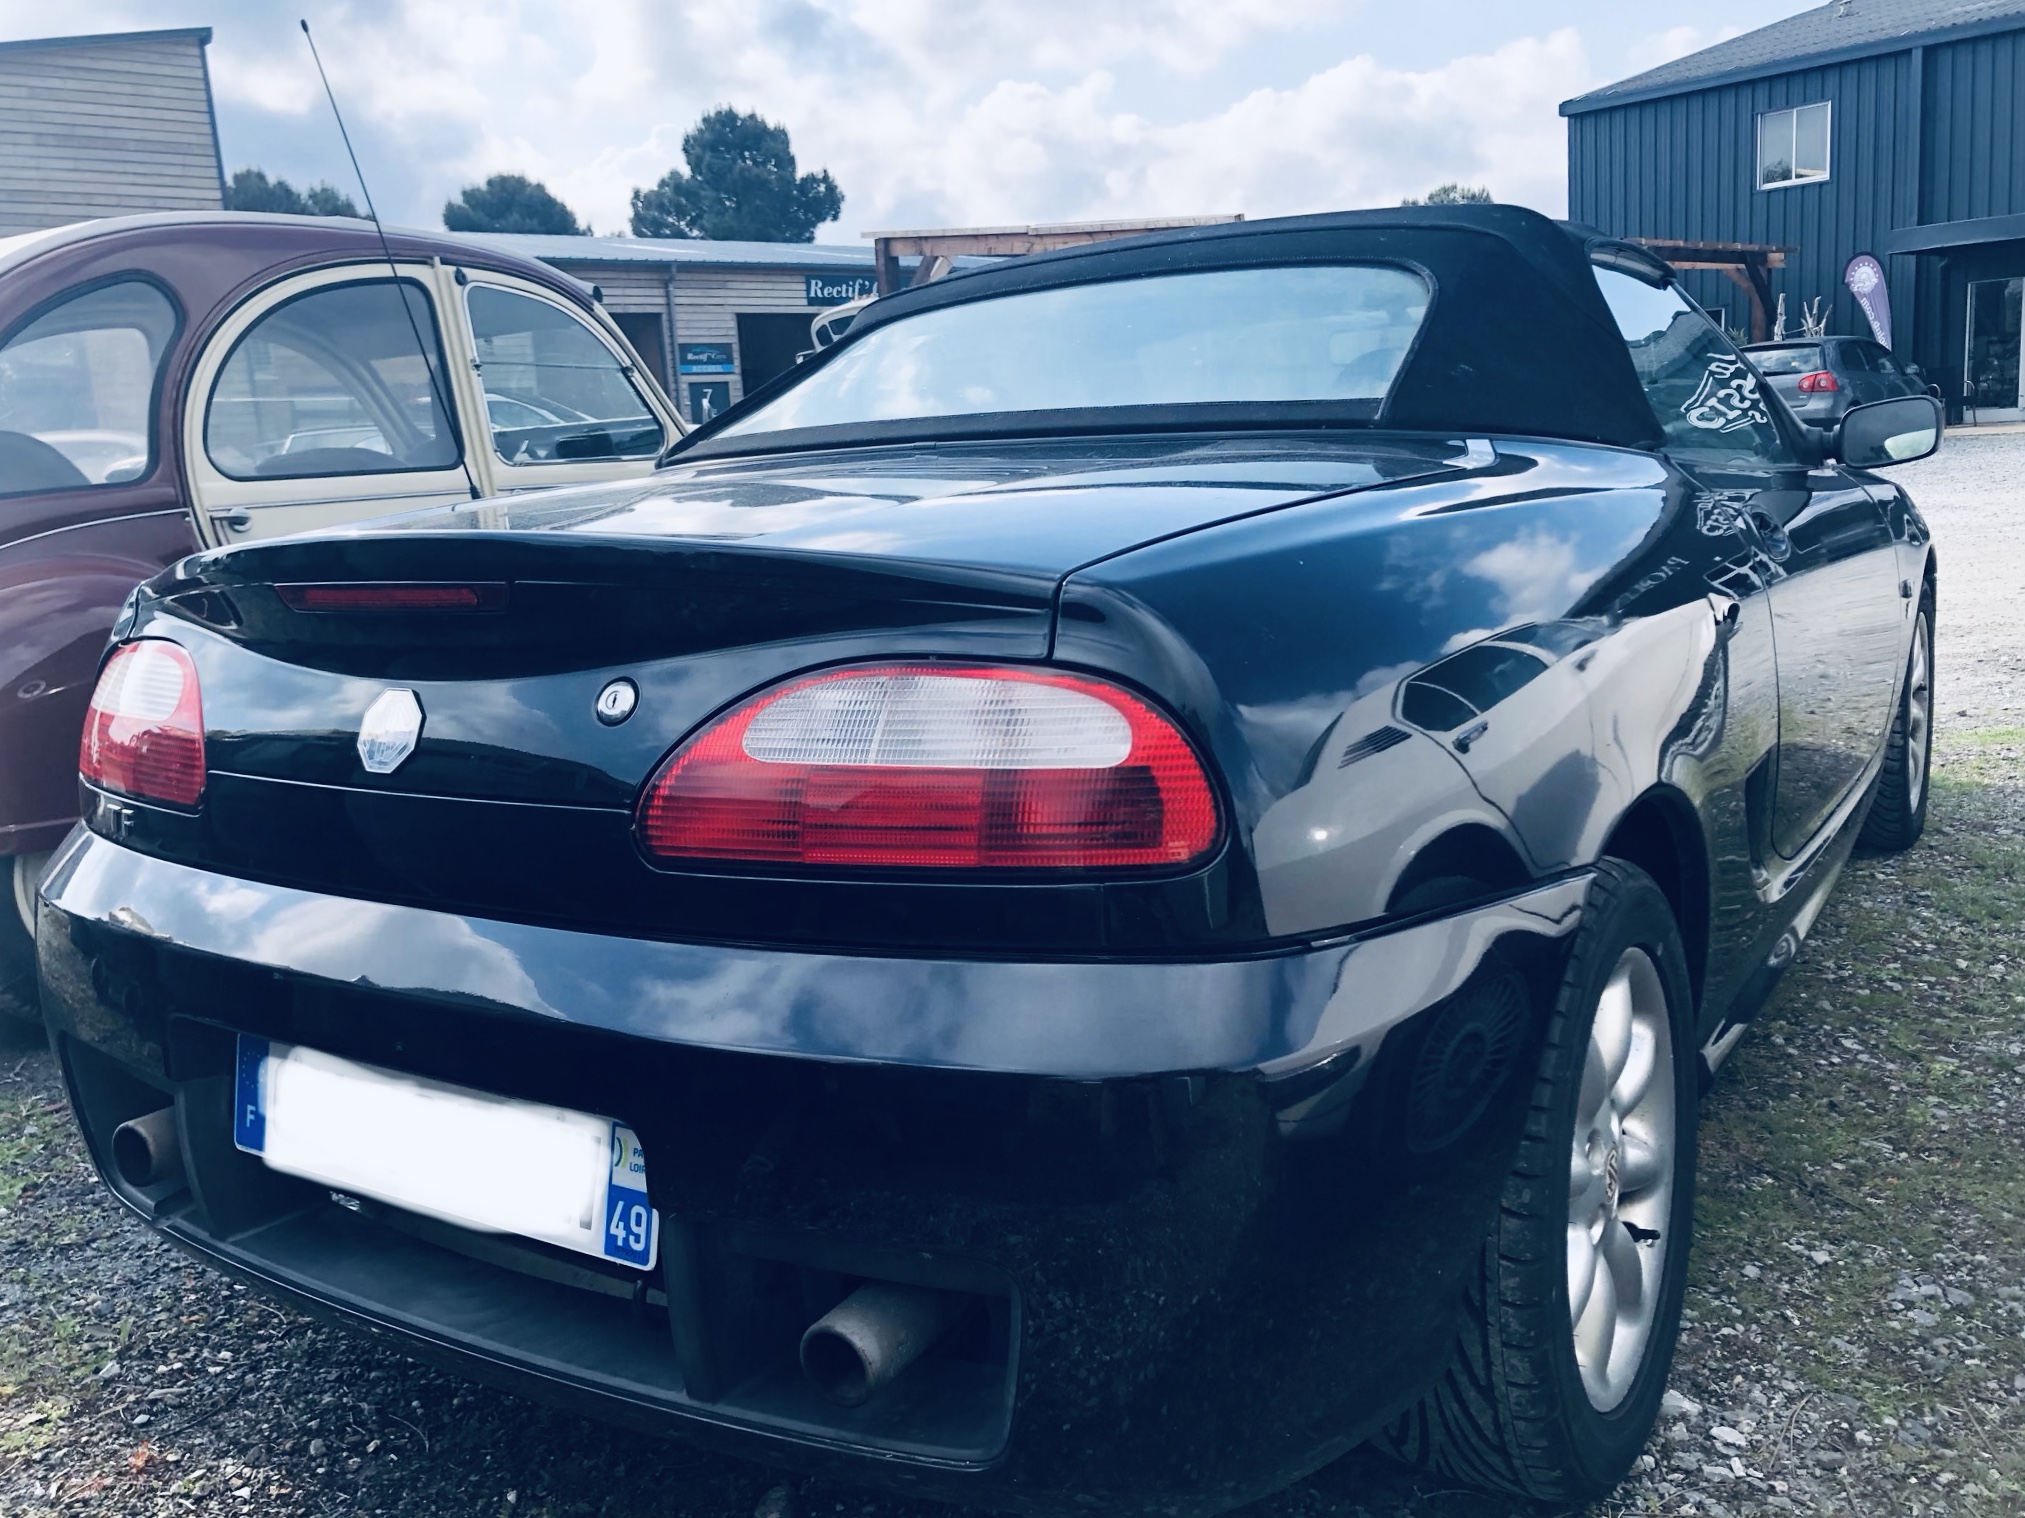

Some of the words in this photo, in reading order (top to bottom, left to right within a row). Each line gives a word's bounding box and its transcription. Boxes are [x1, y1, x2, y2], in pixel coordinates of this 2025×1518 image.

[107, 803, 134, 837] TF
[246, 1104, 256, 1127] F
[633, 1147, 644, 1158] PA
[629, 1161, 646, 1174] LOIR
[609, 1200, 648, 1252] 49
